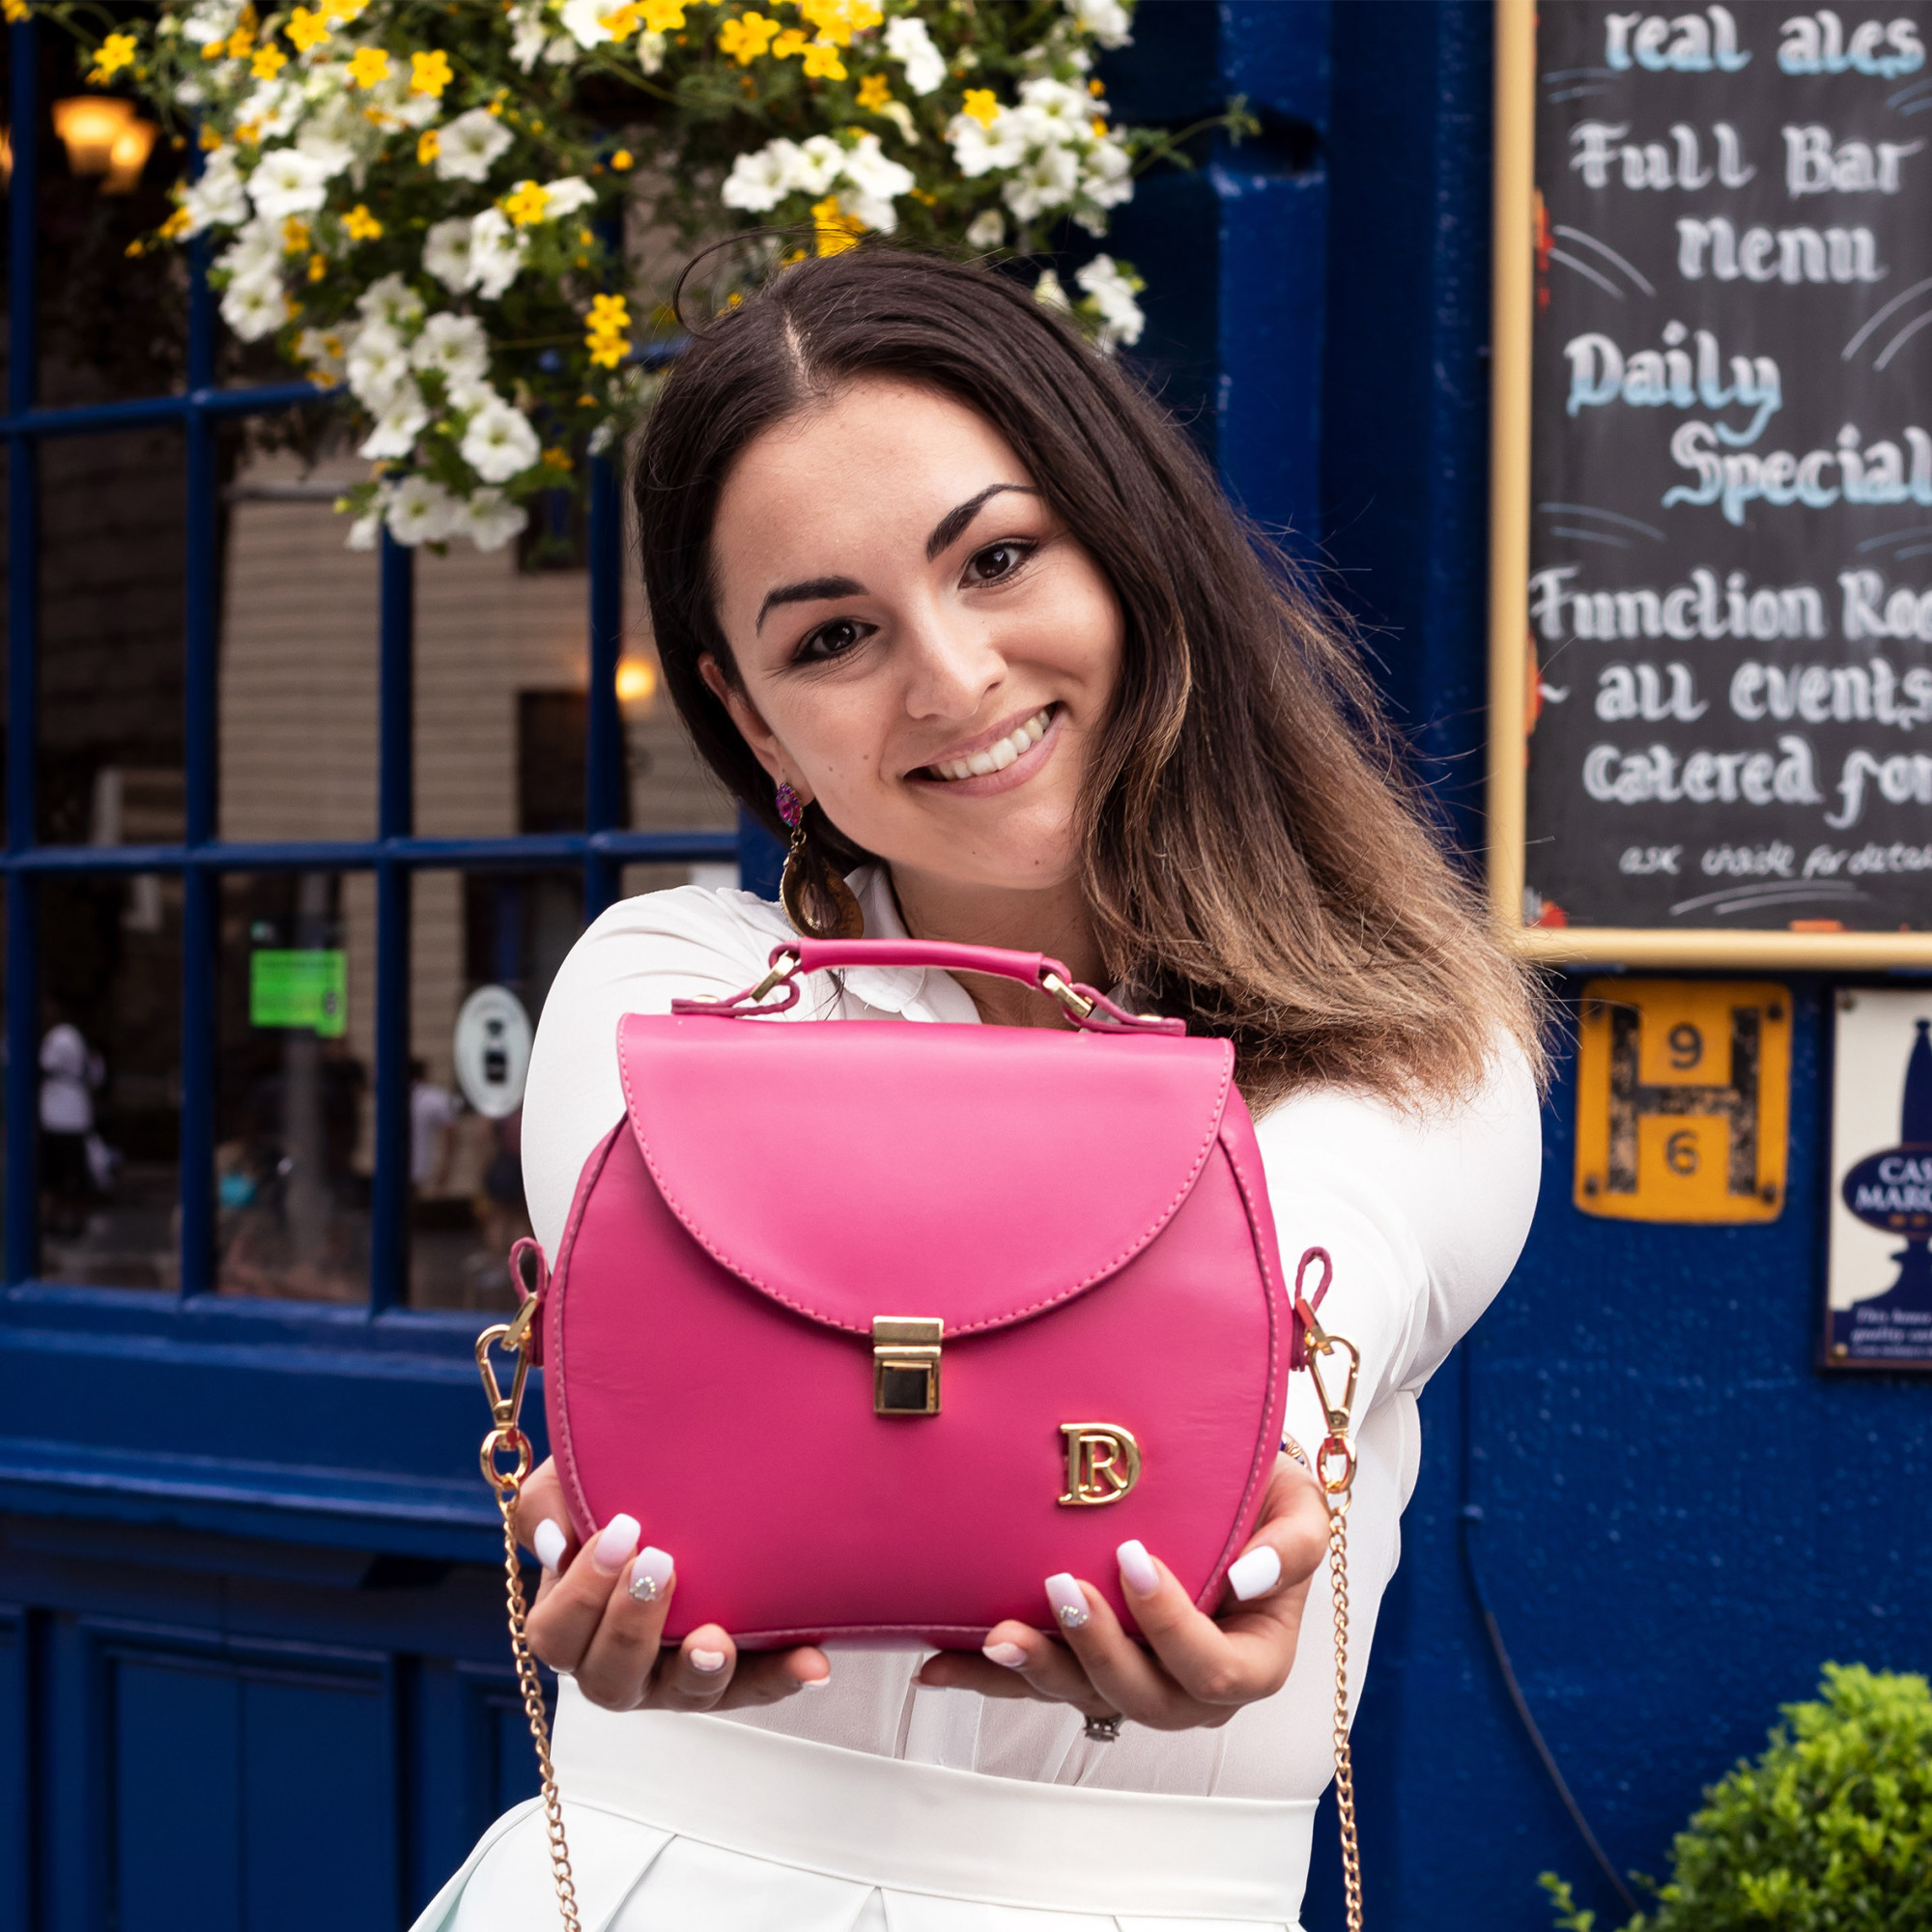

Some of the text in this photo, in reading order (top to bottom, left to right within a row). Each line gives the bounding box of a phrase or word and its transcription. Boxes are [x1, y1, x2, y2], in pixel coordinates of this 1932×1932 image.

[1605, 5, 1926, 78] real ales
[1569, 122, 1926, 199] Full Bar
[1675, 216, 1889, 283] Menu
[1564, 320, 1782, 446] Daily
[1661, 420, 1932, 526] Special
[1528, 564, 1827, 641] Function
[1595, 658, 1932, 731] all events
[1582, 735, 1824, 804] Catered
[1618, 843, 1683, 875] ask
[1802, 842, 1851, 880] for
[1668, 1022, 1703, 1070] 9
[1664, 1129, 1699, 1177] 6
